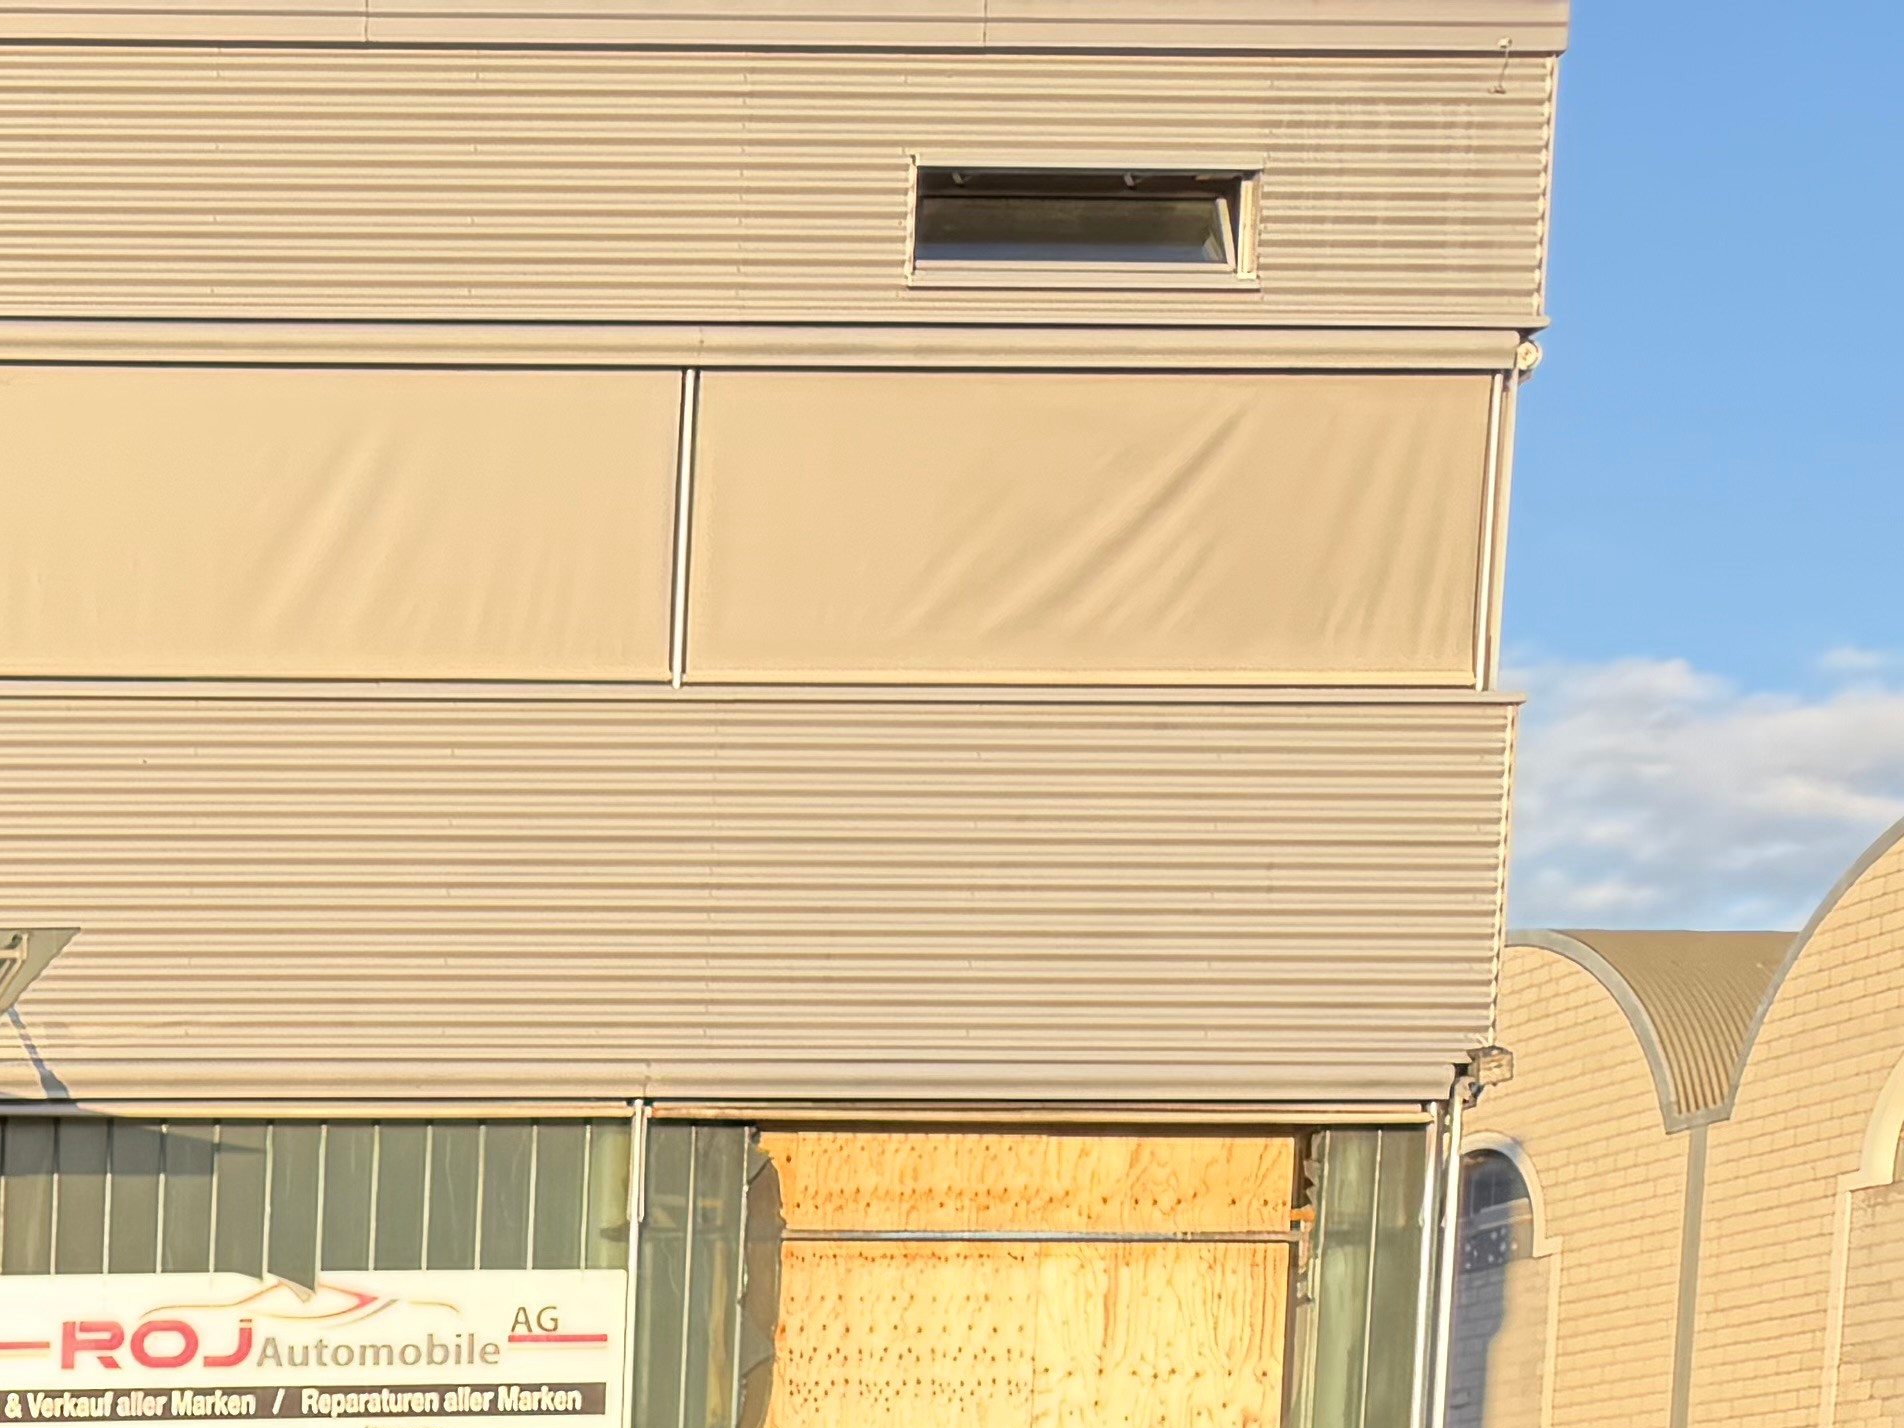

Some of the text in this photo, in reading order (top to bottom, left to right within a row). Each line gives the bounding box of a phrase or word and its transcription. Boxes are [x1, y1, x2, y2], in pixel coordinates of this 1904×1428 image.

[61, 1306, 559, 1369] ROJ Automobile AG
[26, 1391, 114, 1419] Verkauf
[116, 1391, 168, 1418] aller
[171, 1389, 256, 1417] Marken
[301, 1387, 440, 1418] Reparaturen
[443, 1386, 495, 1413] aller
[498, 1385, 583, 1412] Marken
